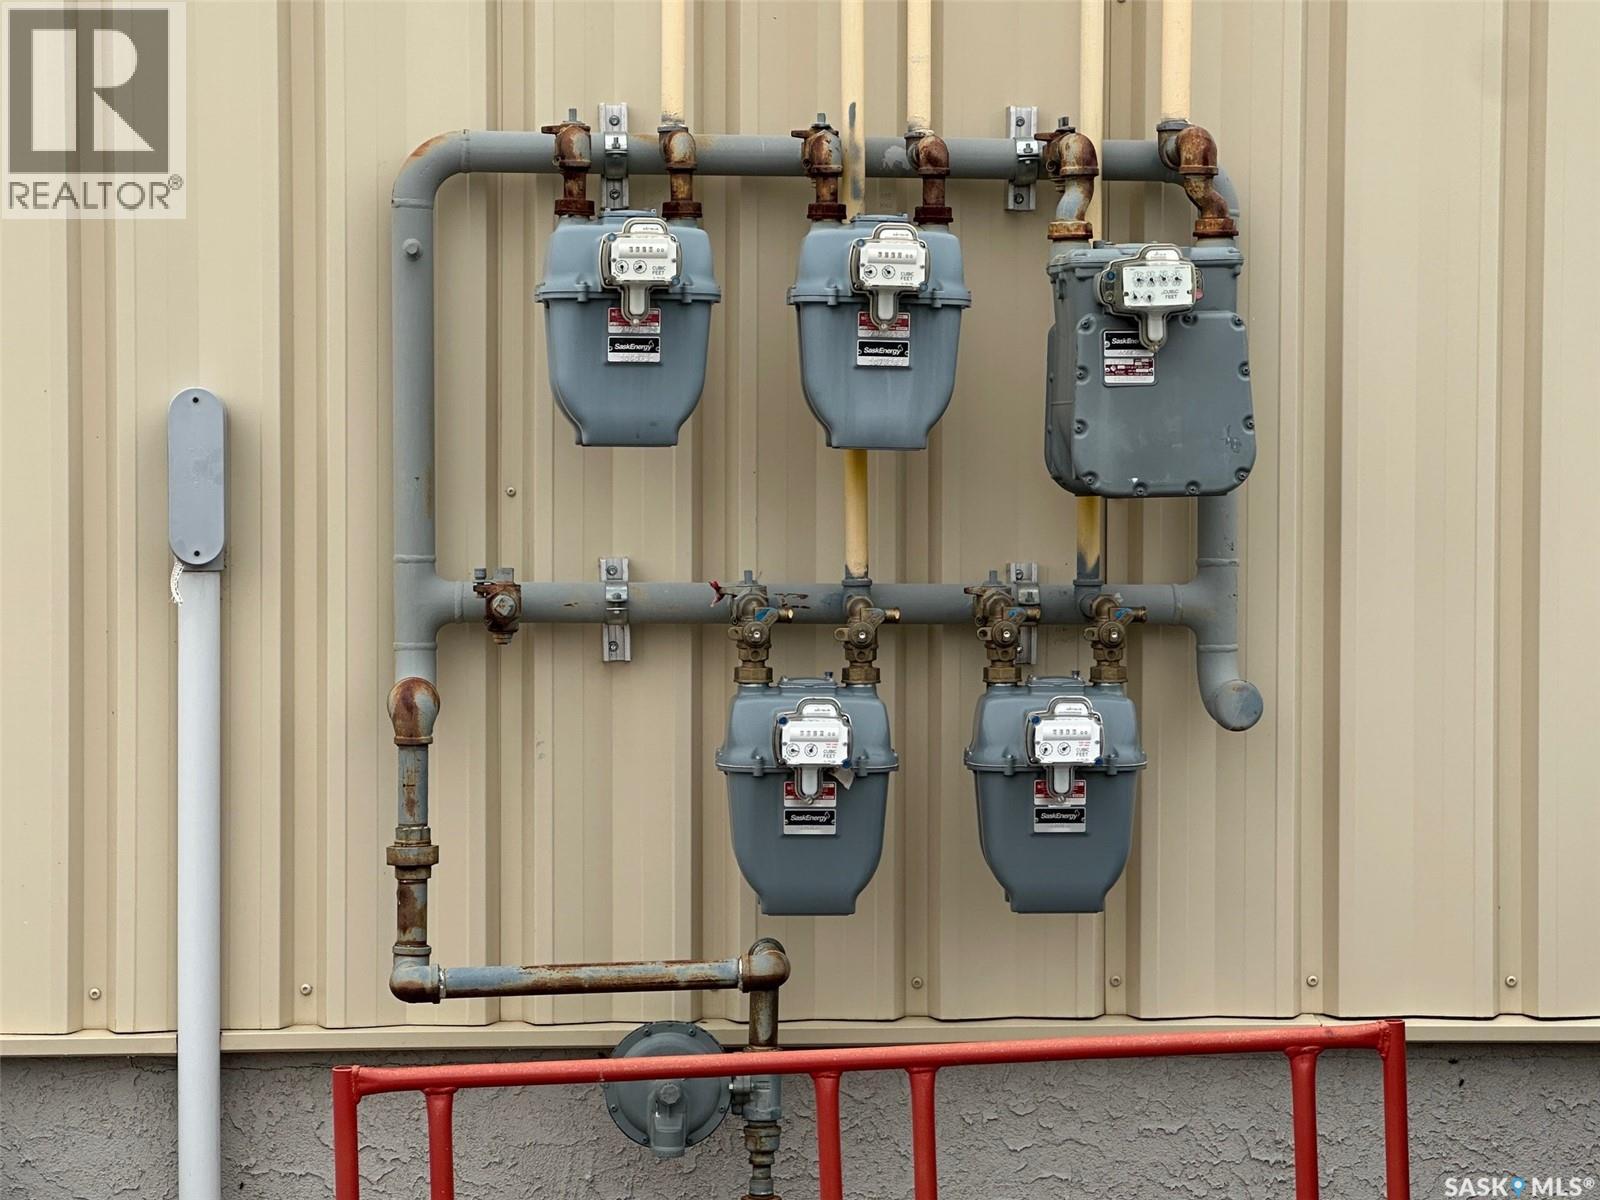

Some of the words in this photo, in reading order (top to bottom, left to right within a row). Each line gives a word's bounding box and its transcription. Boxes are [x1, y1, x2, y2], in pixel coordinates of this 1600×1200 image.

[614, 343, 652, 351] SaskEnergy
[863, 346, 901, 355] SaskEnergy
[790, 814, 828, 822] SaskEnergy
[1040, 812, 1077, 820] SaskEnergy
